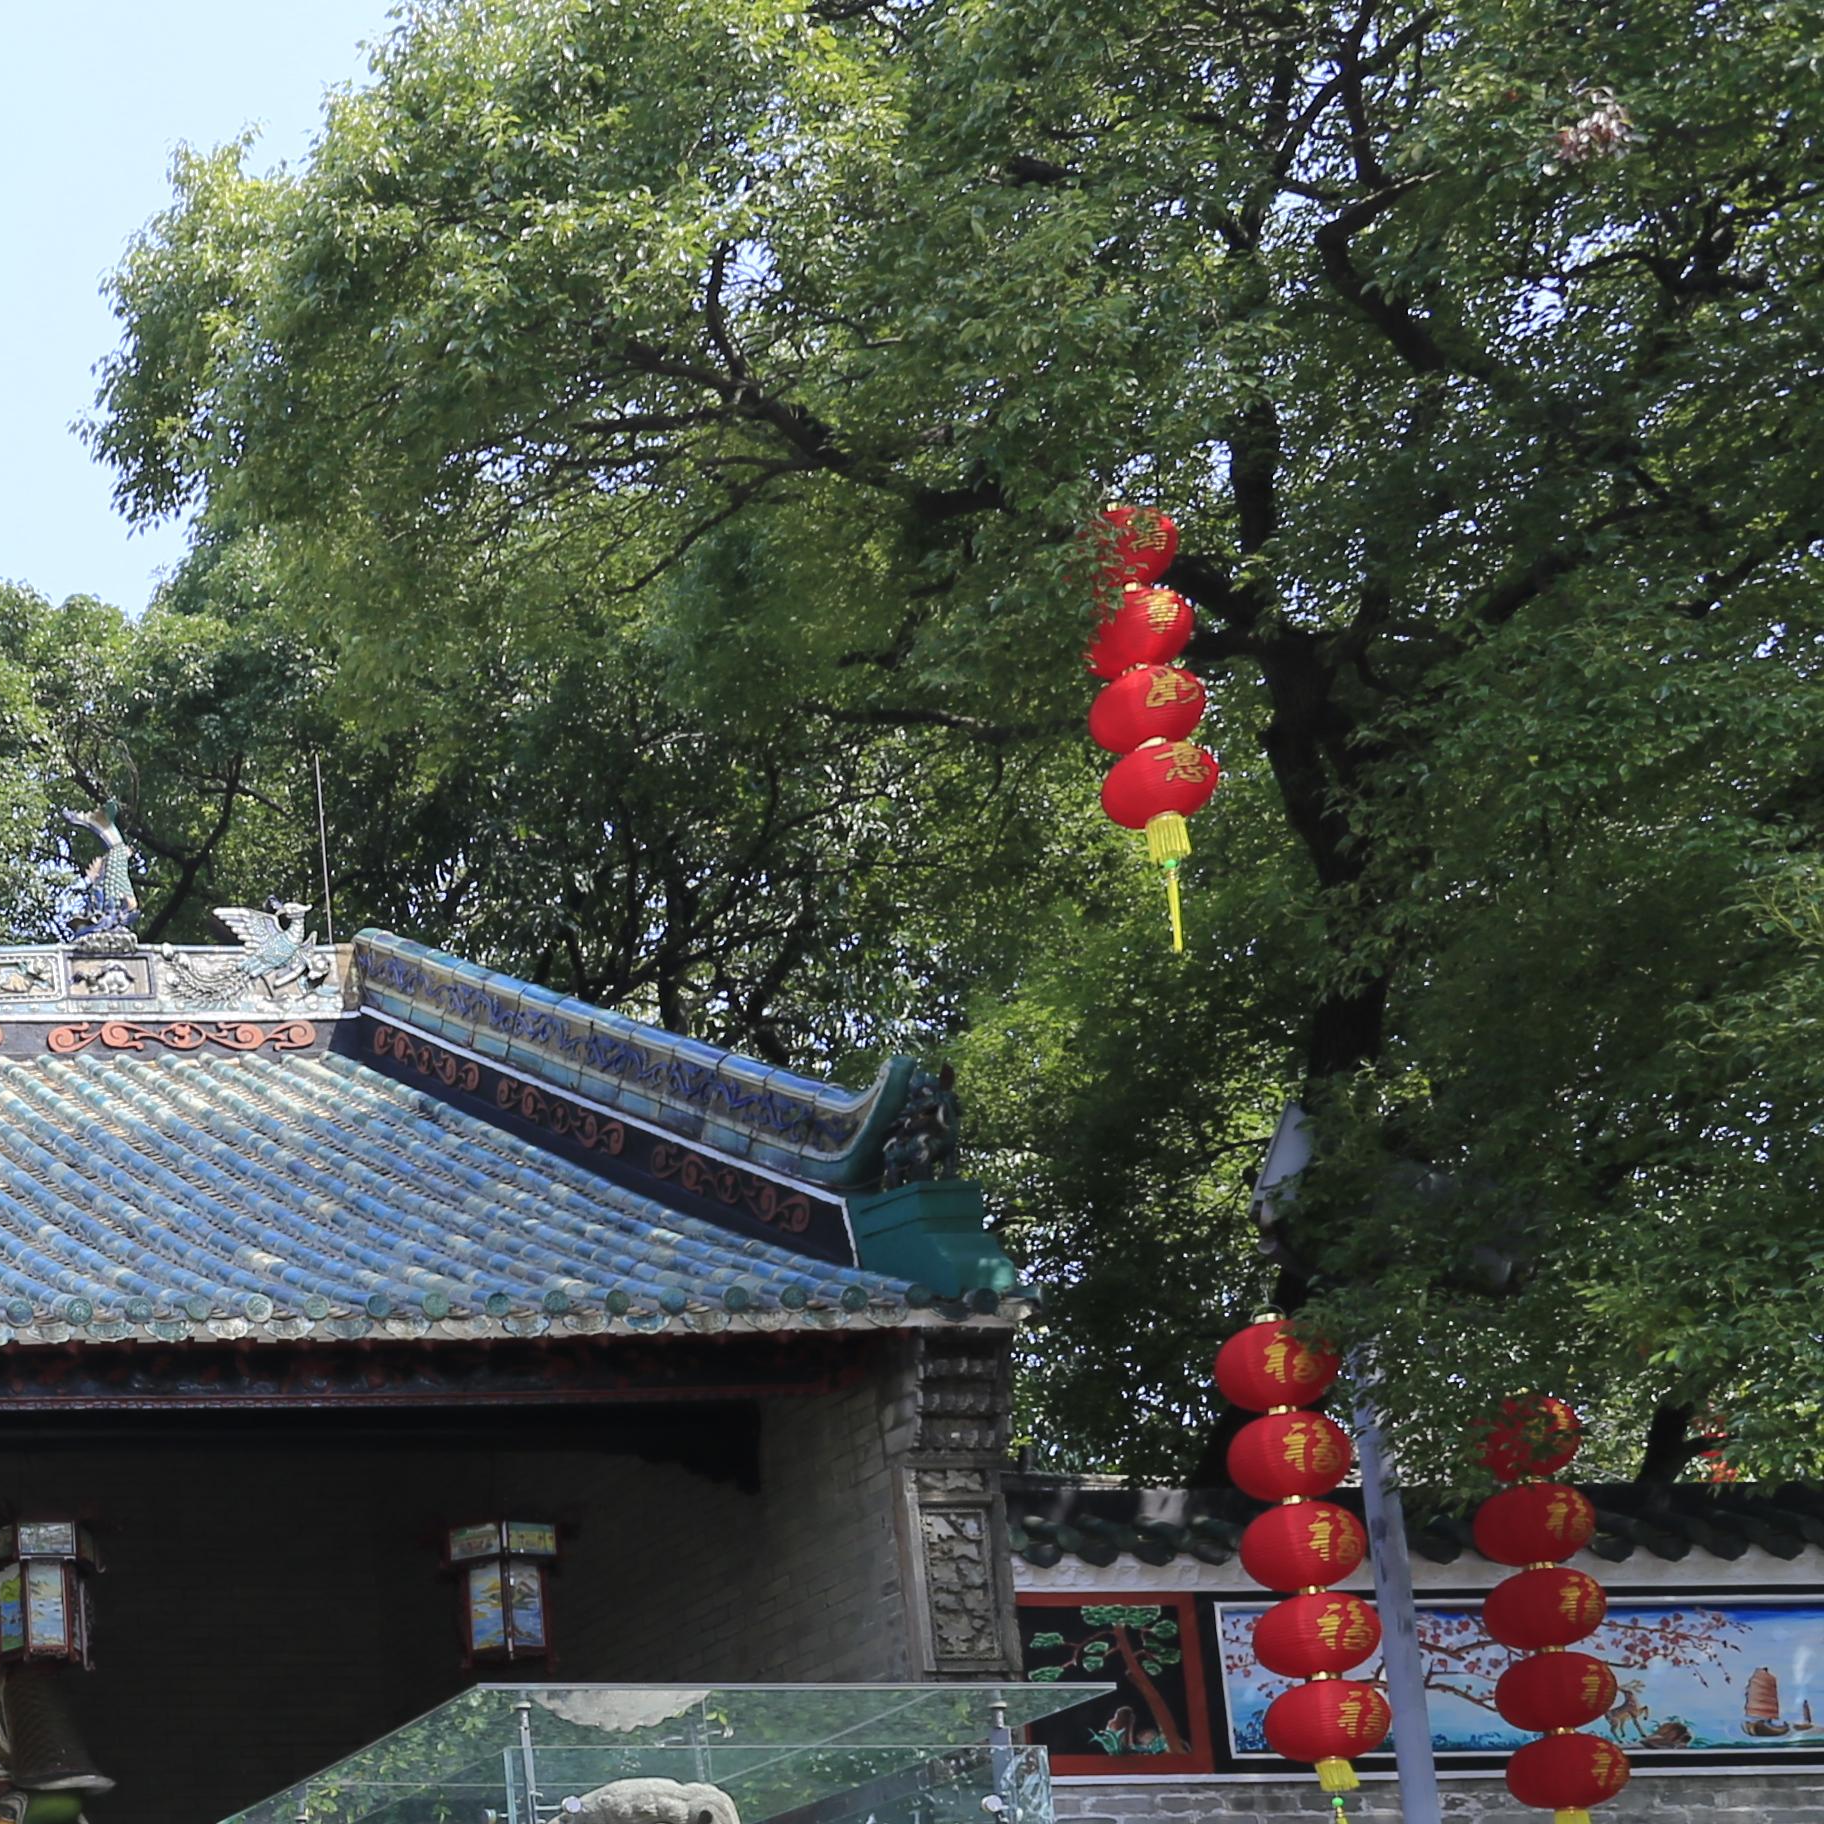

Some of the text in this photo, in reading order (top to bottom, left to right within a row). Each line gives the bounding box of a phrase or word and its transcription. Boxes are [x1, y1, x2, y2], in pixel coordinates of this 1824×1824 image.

[1282, 1420, 1342, 1473] 福
[1308, 1510, 1362, 1565] 福
[1545, 1491, 1593, 1542] 福
[1316, 1600, 1373, 1651] 福
[1337, 1689, 1386, 1739] 福
